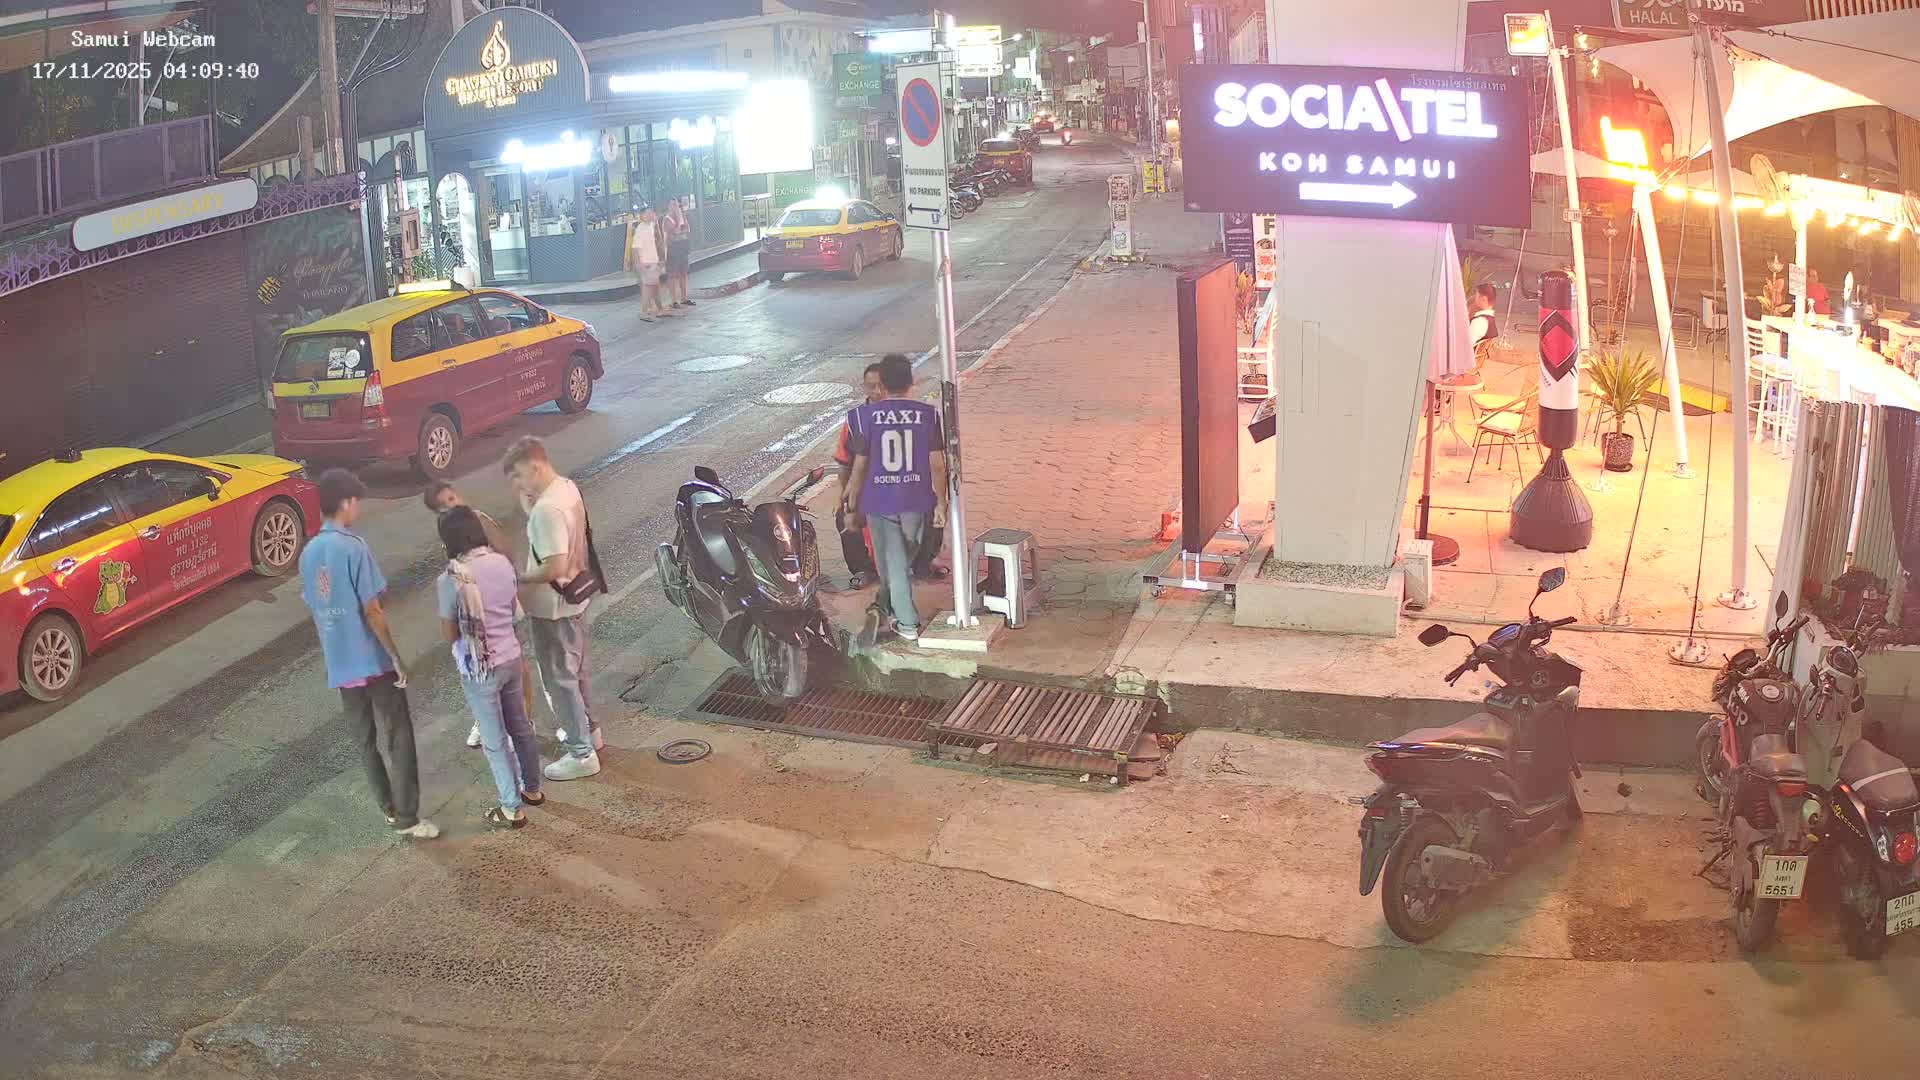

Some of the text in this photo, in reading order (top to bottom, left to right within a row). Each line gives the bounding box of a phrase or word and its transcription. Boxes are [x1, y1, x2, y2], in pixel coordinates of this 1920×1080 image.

[1630, 9, 1679, 25] HALAL
[839, 79, 880, 90] EXCHANGE
[1258, 151, 1456, 180] KOH SAMUI
[909, 187, 942, 197] NO PARKING
[112, 192, 225, 236] DISPENSARY
[872, 410, 922, 425] TAXI
[881, 429, 913, 472] 01
[873, 473, 921, 484] SOUND CLUB
[1764, 884, 1794, 896] 5651
